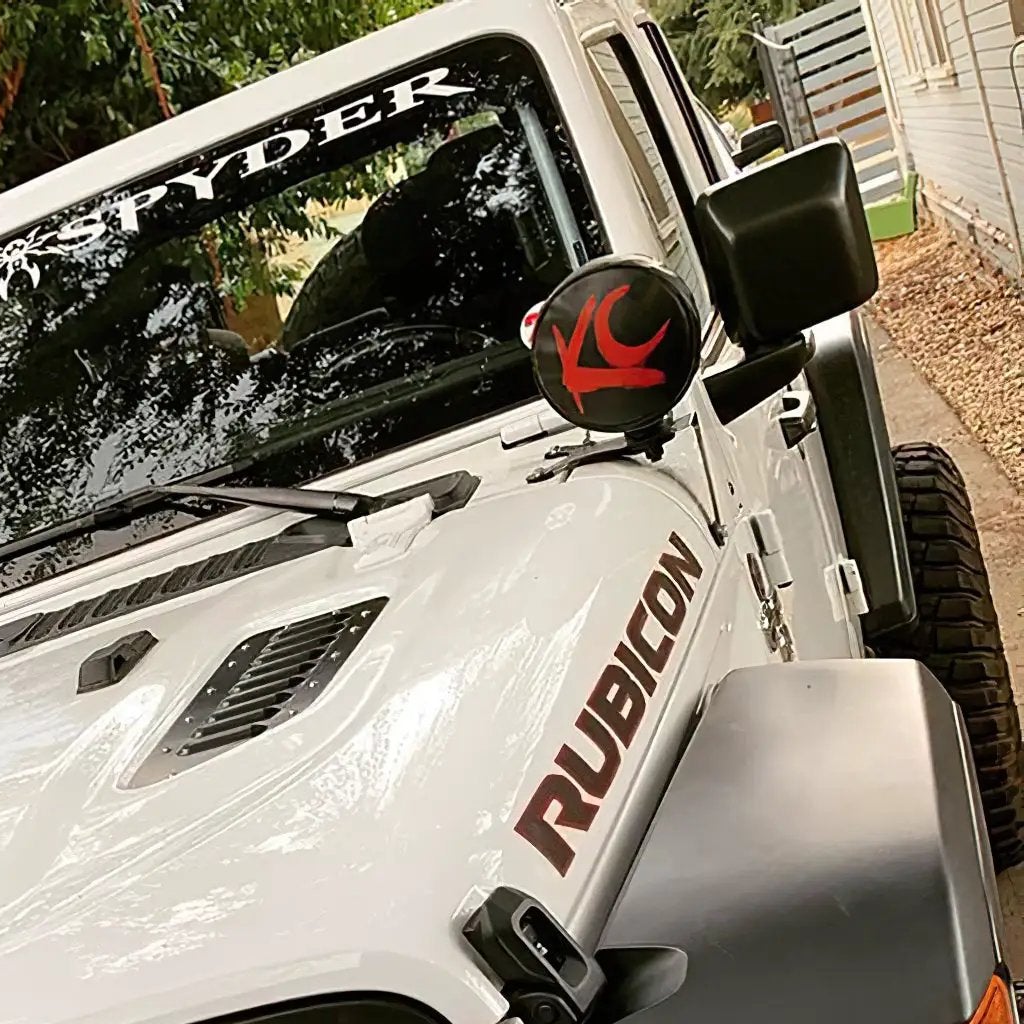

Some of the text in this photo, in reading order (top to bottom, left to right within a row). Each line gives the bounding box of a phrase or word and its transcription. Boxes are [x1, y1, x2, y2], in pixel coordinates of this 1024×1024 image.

[55, 66, 476, 248] SPYDER
[551, 284, 671, 415] KC
[513, 530, 704, 878] RUBICON
